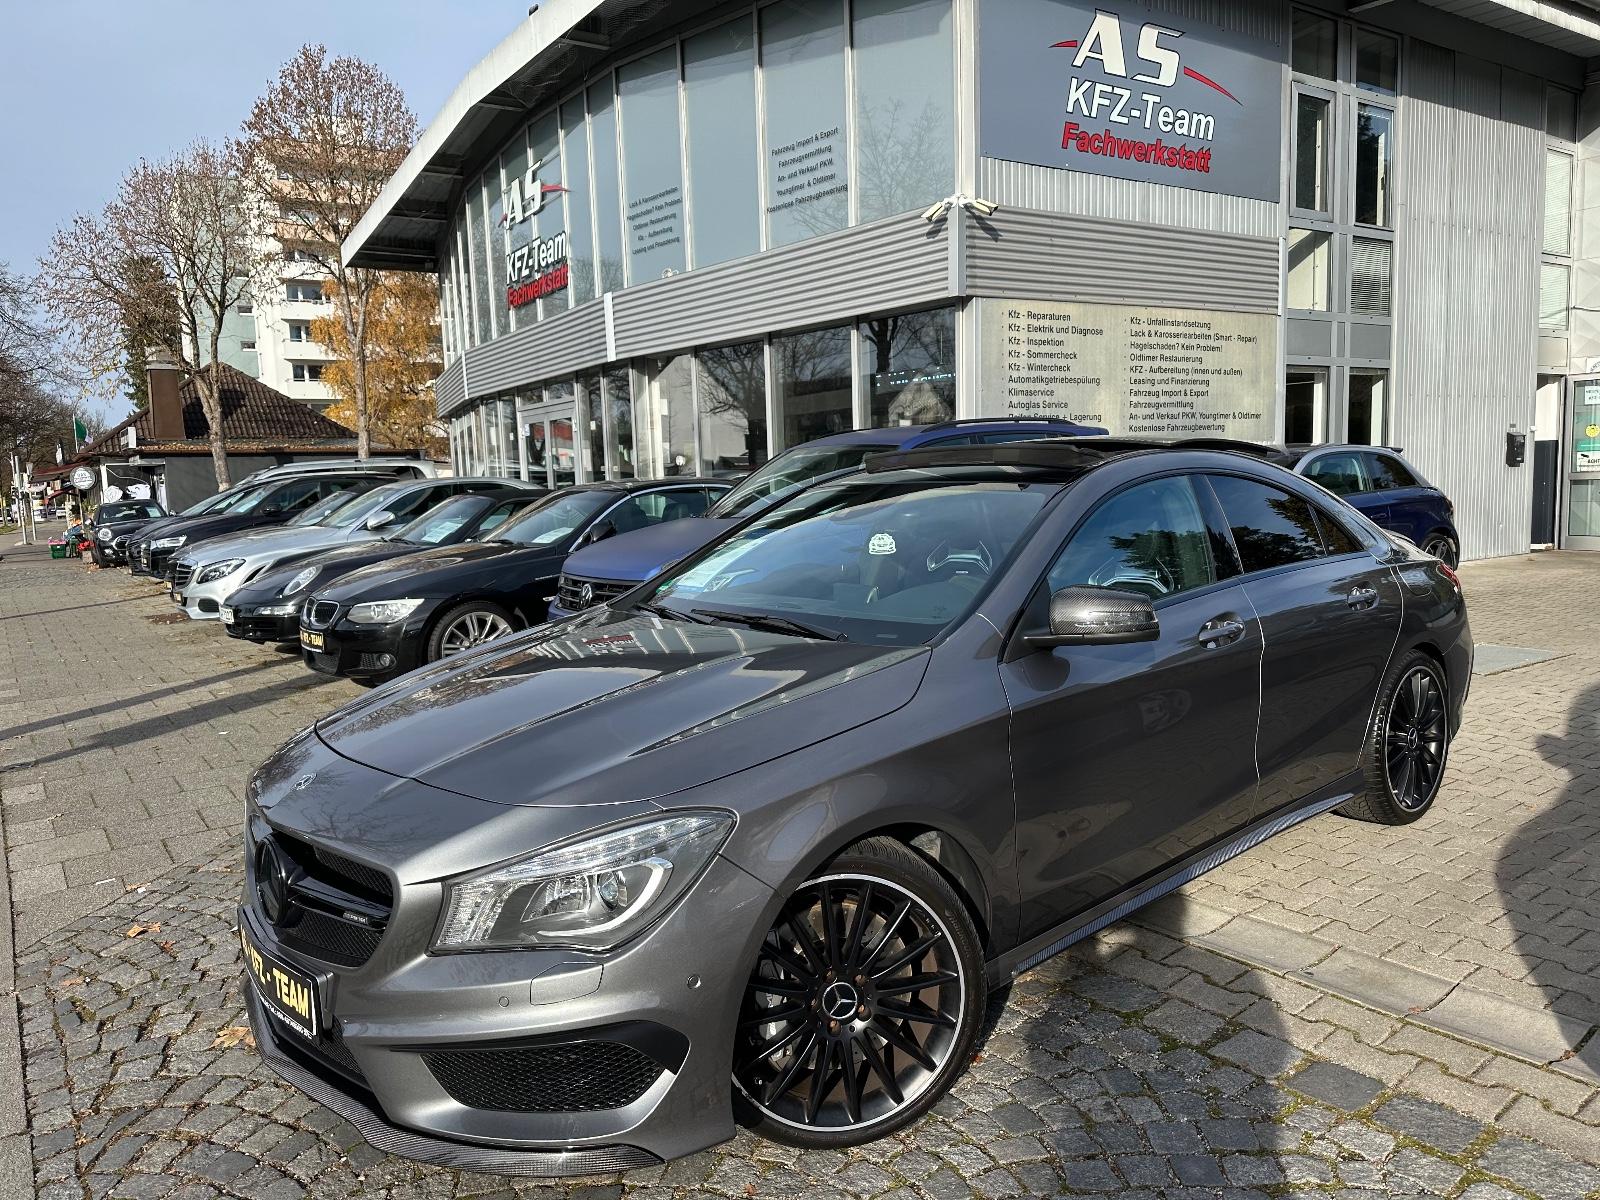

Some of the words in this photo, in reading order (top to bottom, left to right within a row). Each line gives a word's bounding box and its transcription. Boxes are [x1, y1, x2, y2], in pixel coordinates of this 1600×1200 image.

[1071, 8, 1186, 87] AS
[1066, 77, 1215, 141] KFZ-Team
[772, 144, 796, 156] Fahrzeug
[796, 136, 814, 147] Import
[820, 126, 838, 139] Export
[1062, 122, 1212, 173] Fachwerkstatt
[799, 163, 819, 175] Verkauf
[506, 159, 542, 230] AS
[795, 184, 848, 204] Fahrzeugbewertung
[506, 230, 566, 286] KFZ-Team
[508, 263, 568, 310] Fachwerkstatt
[1008, 310, 1020, 318] Kfz
[1027, 311, 1070, 322] Reparaturen
[1008, 323, 1020, 332] Kfz
[1027, 324, 1054, 333] Elektrik
[1071, 326, 1103, 336] Diagnose
[1147, 318, 1211, 330] Unfallinstandsetzung
[1008, 337, 1020, 345] Kfz
[1027, 337, 1064, 347] Inspektion
[1130, 329, 1145, 337] Lack
[1154, 330, 1211, 340] Karosseriearbeiten
[1213, 333, 1232, 342] (Smart
[1237, 335, 1257, 344] Repair)
[1130, 342, 1179, 351] Hagelschaden?
[1196, 344, 1222, 352] Problem!
[1008, 350, 1020, 358] Kfz
[1027, 350, 1078, 359] Sommercheck
[1160, 354, 1203, 364] Restaurierung
[1008, 363, 1020, 371] Kfz
[1027, 363, 1071, 372] Wintercheck
[1149, 366, 1189, 376] Aufbereitung
[1191, 367, 1209, 376] (innen
[1008, 375, 1101, 386] Automatikgetriebespülung
[1130, 377, 1155, 386] Leasing
[1171, 378, 1210, 387] Finanzierung
[1008, 388, 1055, 396] Klimaservice
[1130, 389, 1160, 398] Fahrzeug
[1162, 389, 1181, 398] Import
[1190, 389, 1209, 398] Export
[1008, 401, 1040, 410] Autoglas
[1042, 401, 1068, 409] Service
[1130, 400, 1194, 410] Fahrzeugvermittlung
[1070, 413, 1101, 422] Lagerung
[1199, 412, 1231, 421] Youngtimer
[1129, 424, 1165, 432] Kostenlose
[1167, 424, 1225, 432] Fahrzeugbewertung
[272, 967, 309, 1019] TEAM
